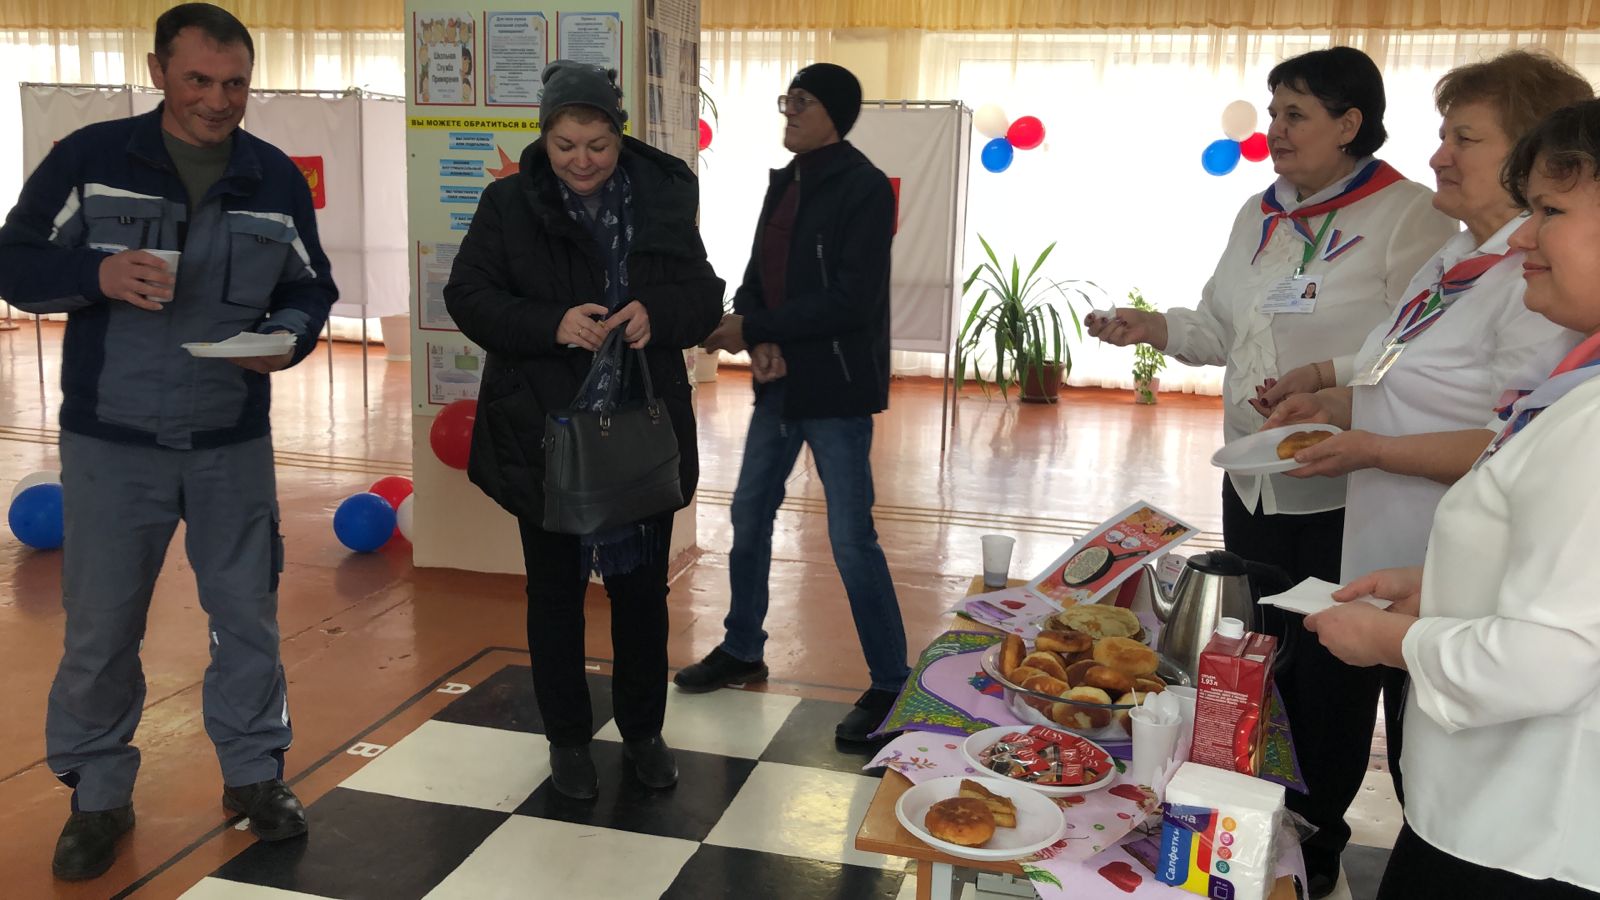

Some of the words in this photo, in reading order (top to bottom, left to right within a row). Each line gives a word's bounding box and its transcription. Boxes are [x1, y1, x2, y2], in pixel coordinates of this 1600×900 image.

[433, 52, 456, 60] Школьная
[436, 63, 454, 73] Служба
[426, 119, 462, 127] МОЖЕТЕ
[464, 120, 519, 129] ОБРАТИТЬСЯ
[1201, 678, 1214, 686] 1,93
[437, 682, 471, 694] A
[346, 741, 388, 758] B
